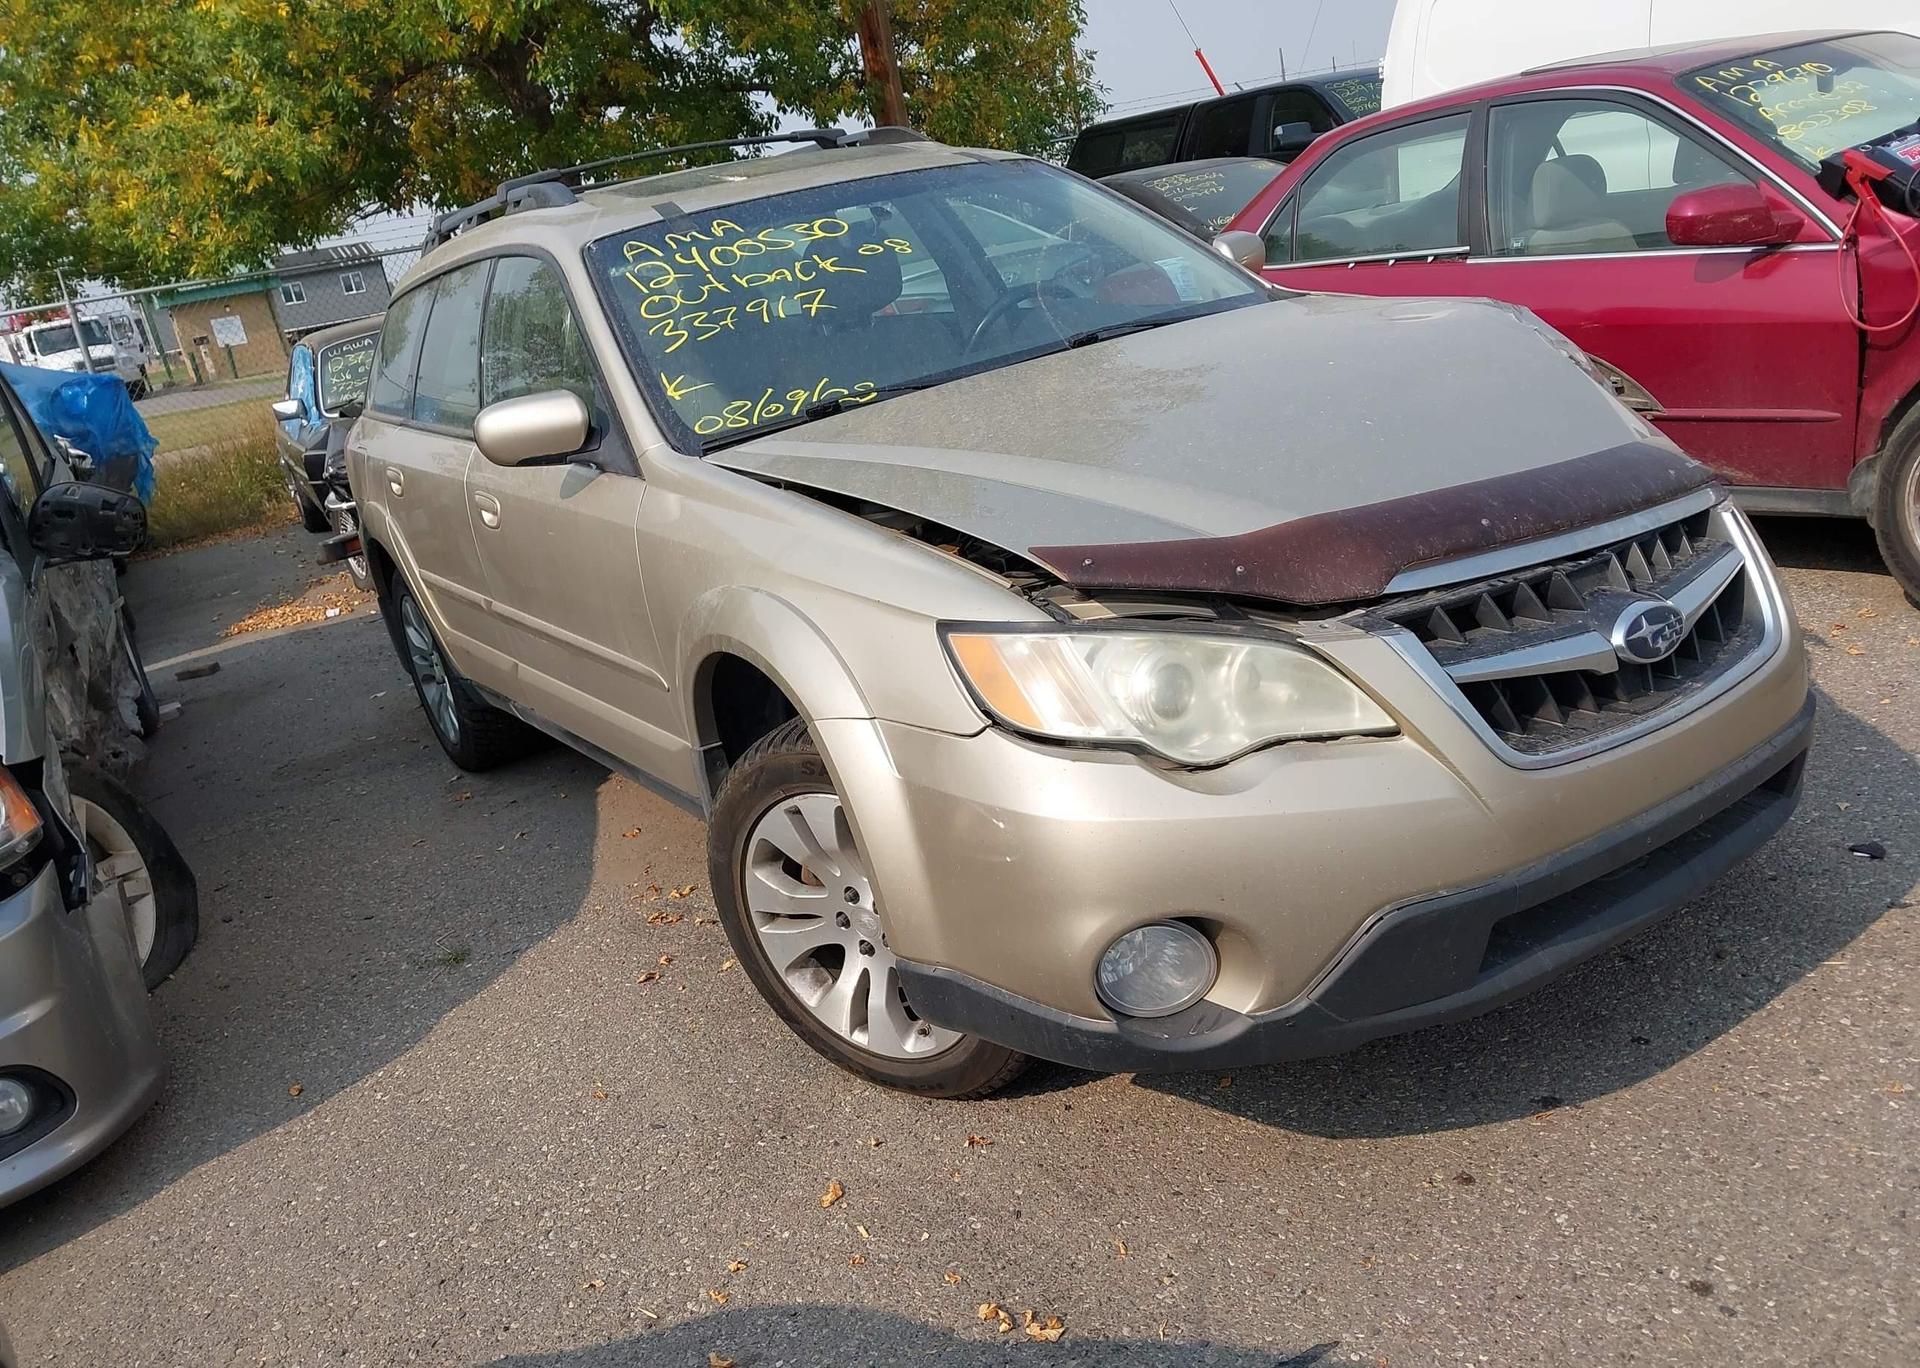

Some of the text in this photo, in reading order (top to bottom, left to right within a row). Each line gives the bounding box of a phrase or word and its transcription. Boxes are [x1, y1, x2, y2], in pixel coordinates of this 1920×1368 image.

[1695, 59, 1783, 93] AMA
[623, 219, 745, 263] AMA
[858, 238, 913, 255] 08
[648, 288, 838, 354] 337917
[327, 337, 374, 358] WAWA
